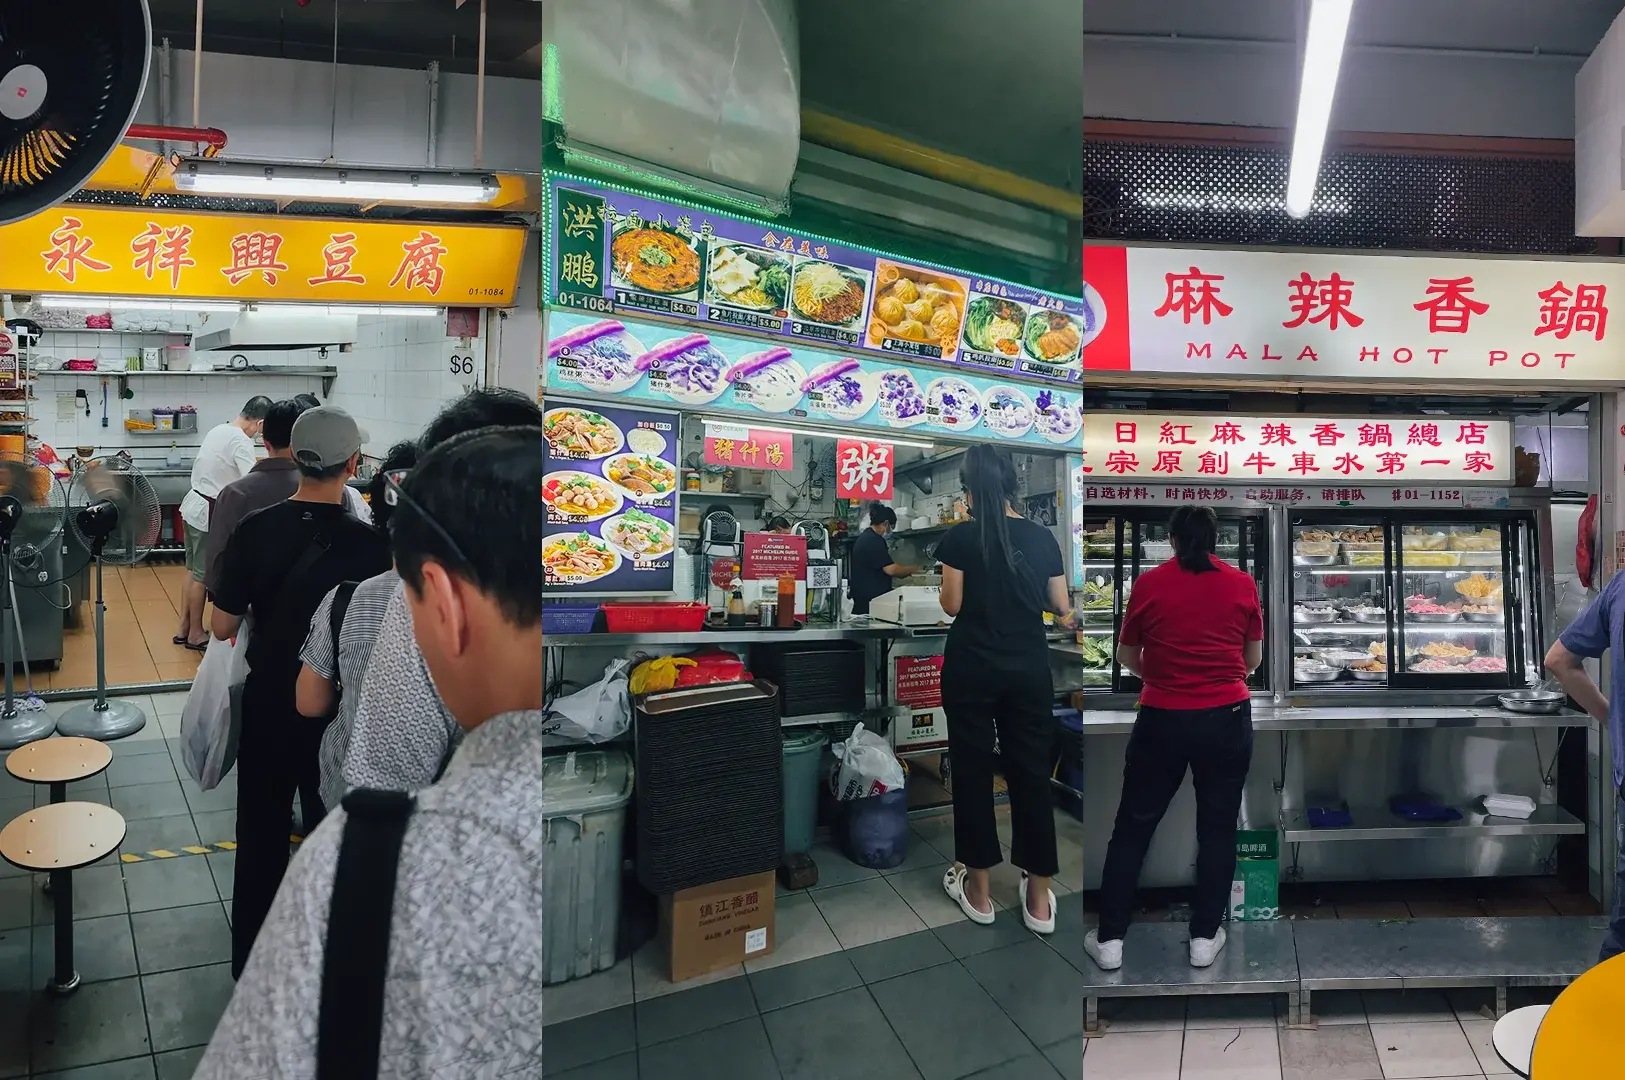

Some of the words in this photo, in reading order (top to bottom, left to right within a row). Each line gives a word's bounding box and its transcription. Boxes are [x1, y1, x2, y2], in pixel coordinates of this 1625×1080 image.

[40, 216, 448, 296] 永祥興豆腐
[468, 287, 504, 297] 01-1084
[559, 292, 614, 313] 01-1064
[617, 292, 626, 304] 1
[673, 304, 697, 314] $4.00
[1154, 266, 1608, 341] 麻辣香鍋
[710, 308, 720, 320] 2
[759, 318, 781, 329] $5.00
[793, 323, 802, 334] 3
[884, 340, 892, 349] 4
[450, 355, 473, 375] $6
[557, 359, 577, 368] $4.00
[963, 352, 970, 362] 5
[1186, 343, 1318, 361] MALA
[1360, 346, 1449, 365] HOT
[1489, 350, 1576, 369] POT
[1021, 363, 1029, 371] 6
[1083, 421, 1489, 447] 日紅麻辣香鍋總店
[840, 442, 889, 494] 粥
[908, 665, 930, 673] FEATURED
[734, 906, 759, 917] VINEGAR
[704, 932, 722, 941] MADE
[733, 924, 751, 933] CHINA
